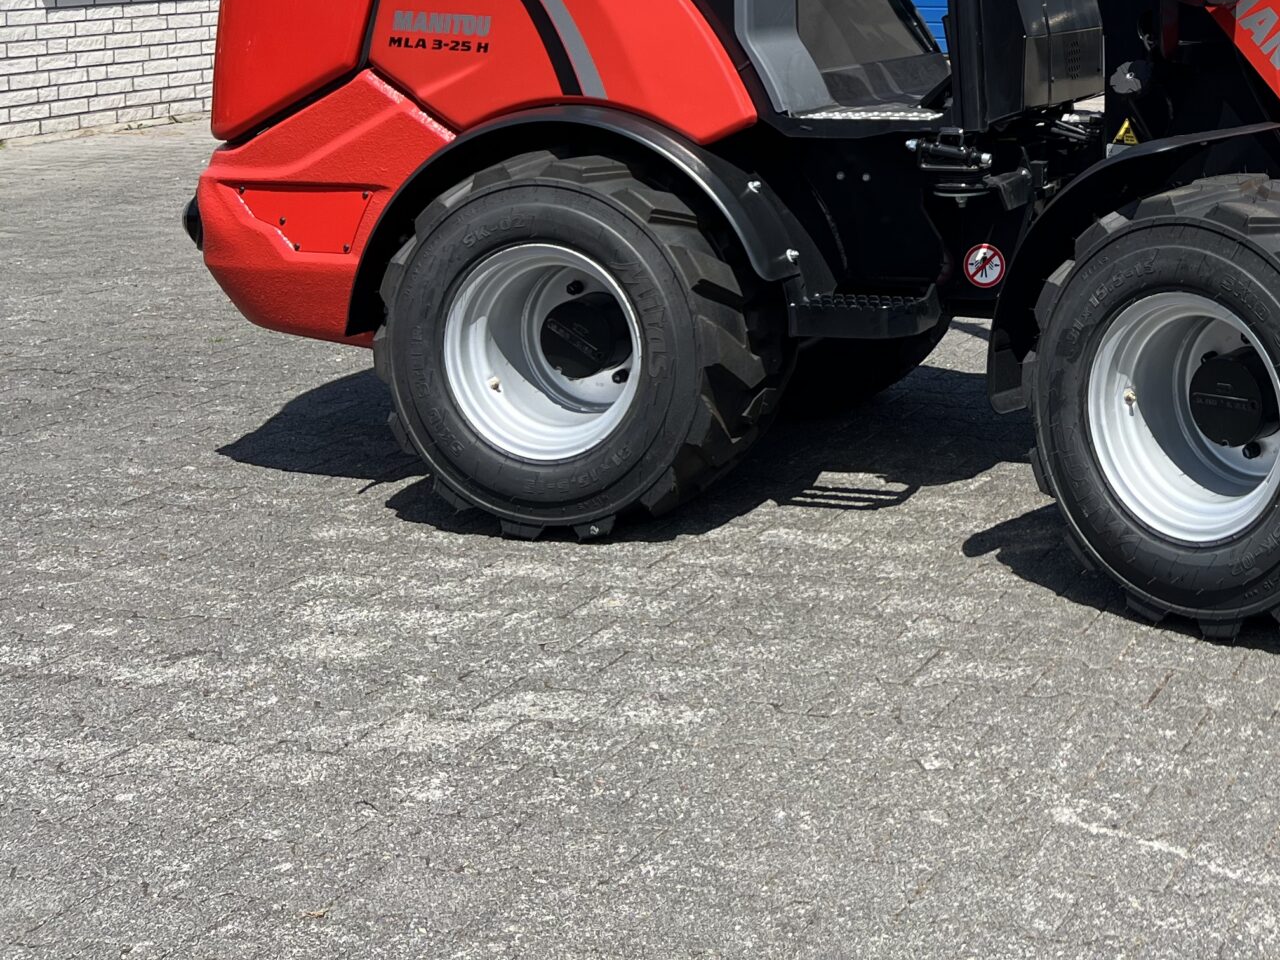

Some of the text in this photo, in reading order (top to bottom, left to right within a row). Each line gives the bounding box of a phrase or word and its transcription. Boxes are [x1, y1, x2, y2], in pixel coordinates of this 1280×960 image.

[392, 10, 492, 37] MANITOU
[388, 36, 490, 54] MLA 3-25 H
[462, 214, 527, 249] SK-02
